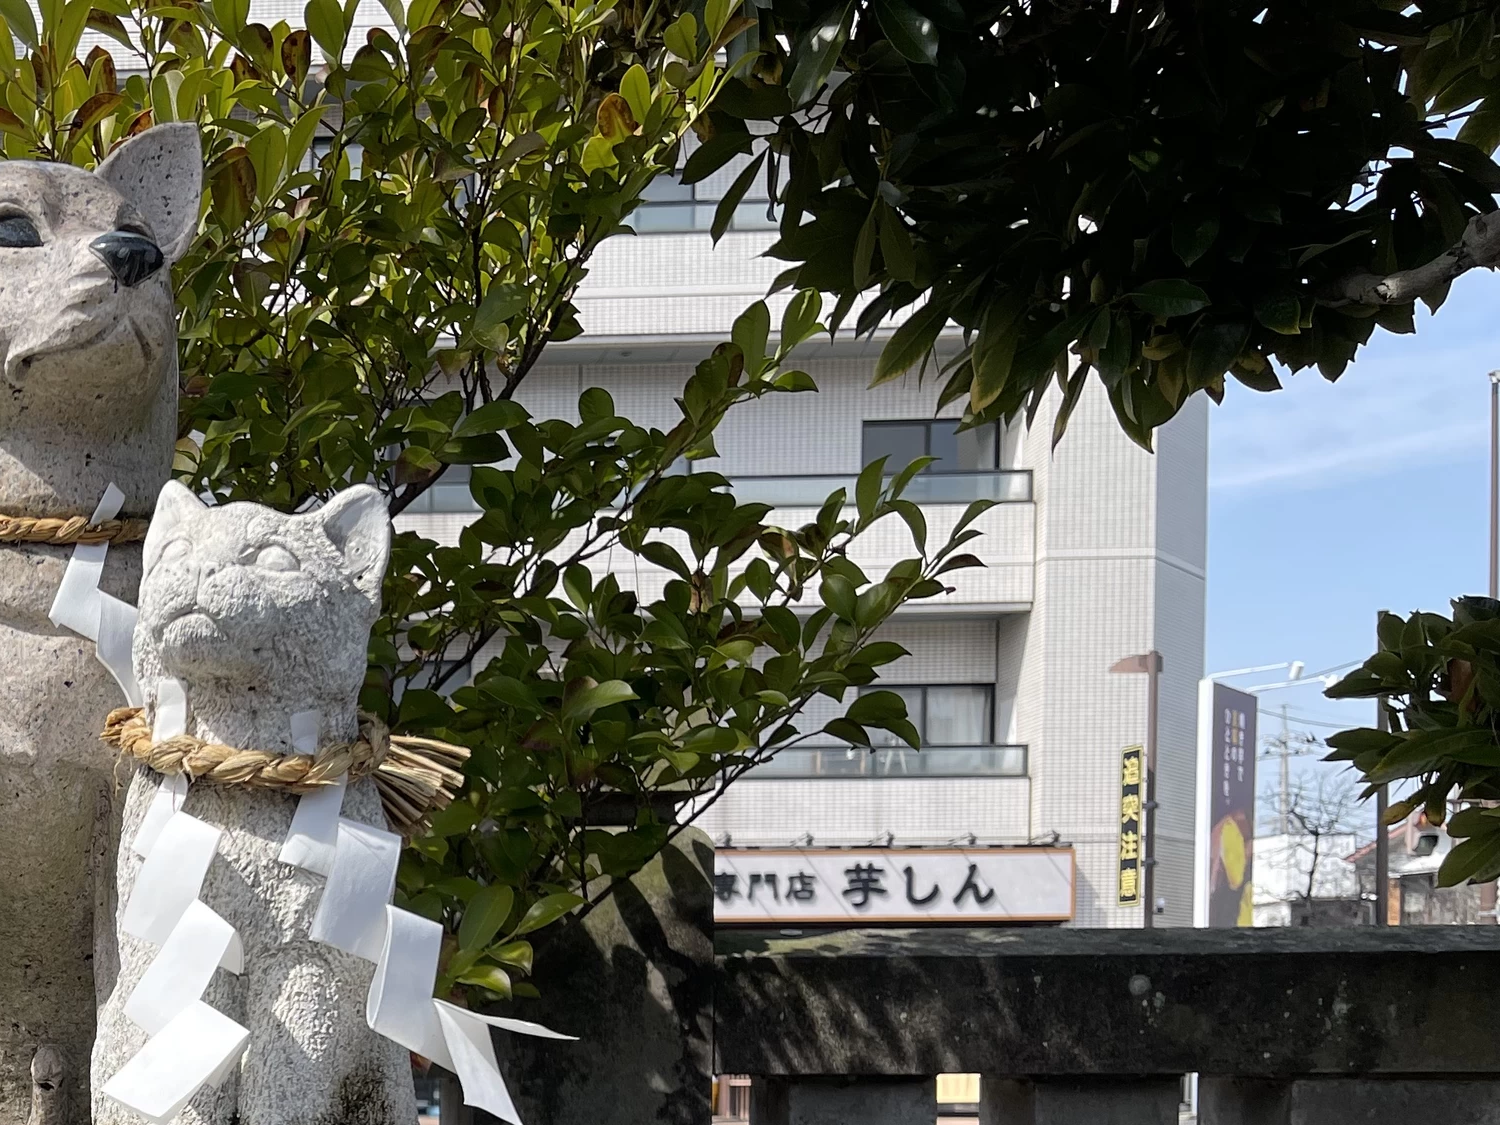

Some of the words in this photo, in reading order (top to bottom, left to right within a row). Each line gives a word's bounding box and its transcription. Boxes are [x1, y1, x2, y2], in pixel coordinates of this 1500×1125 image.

[1120, 755, 1140, 897] 追突注意
[715, 871, 816, 900] 専門店
[842, 863, 995, 906] 芋しん
